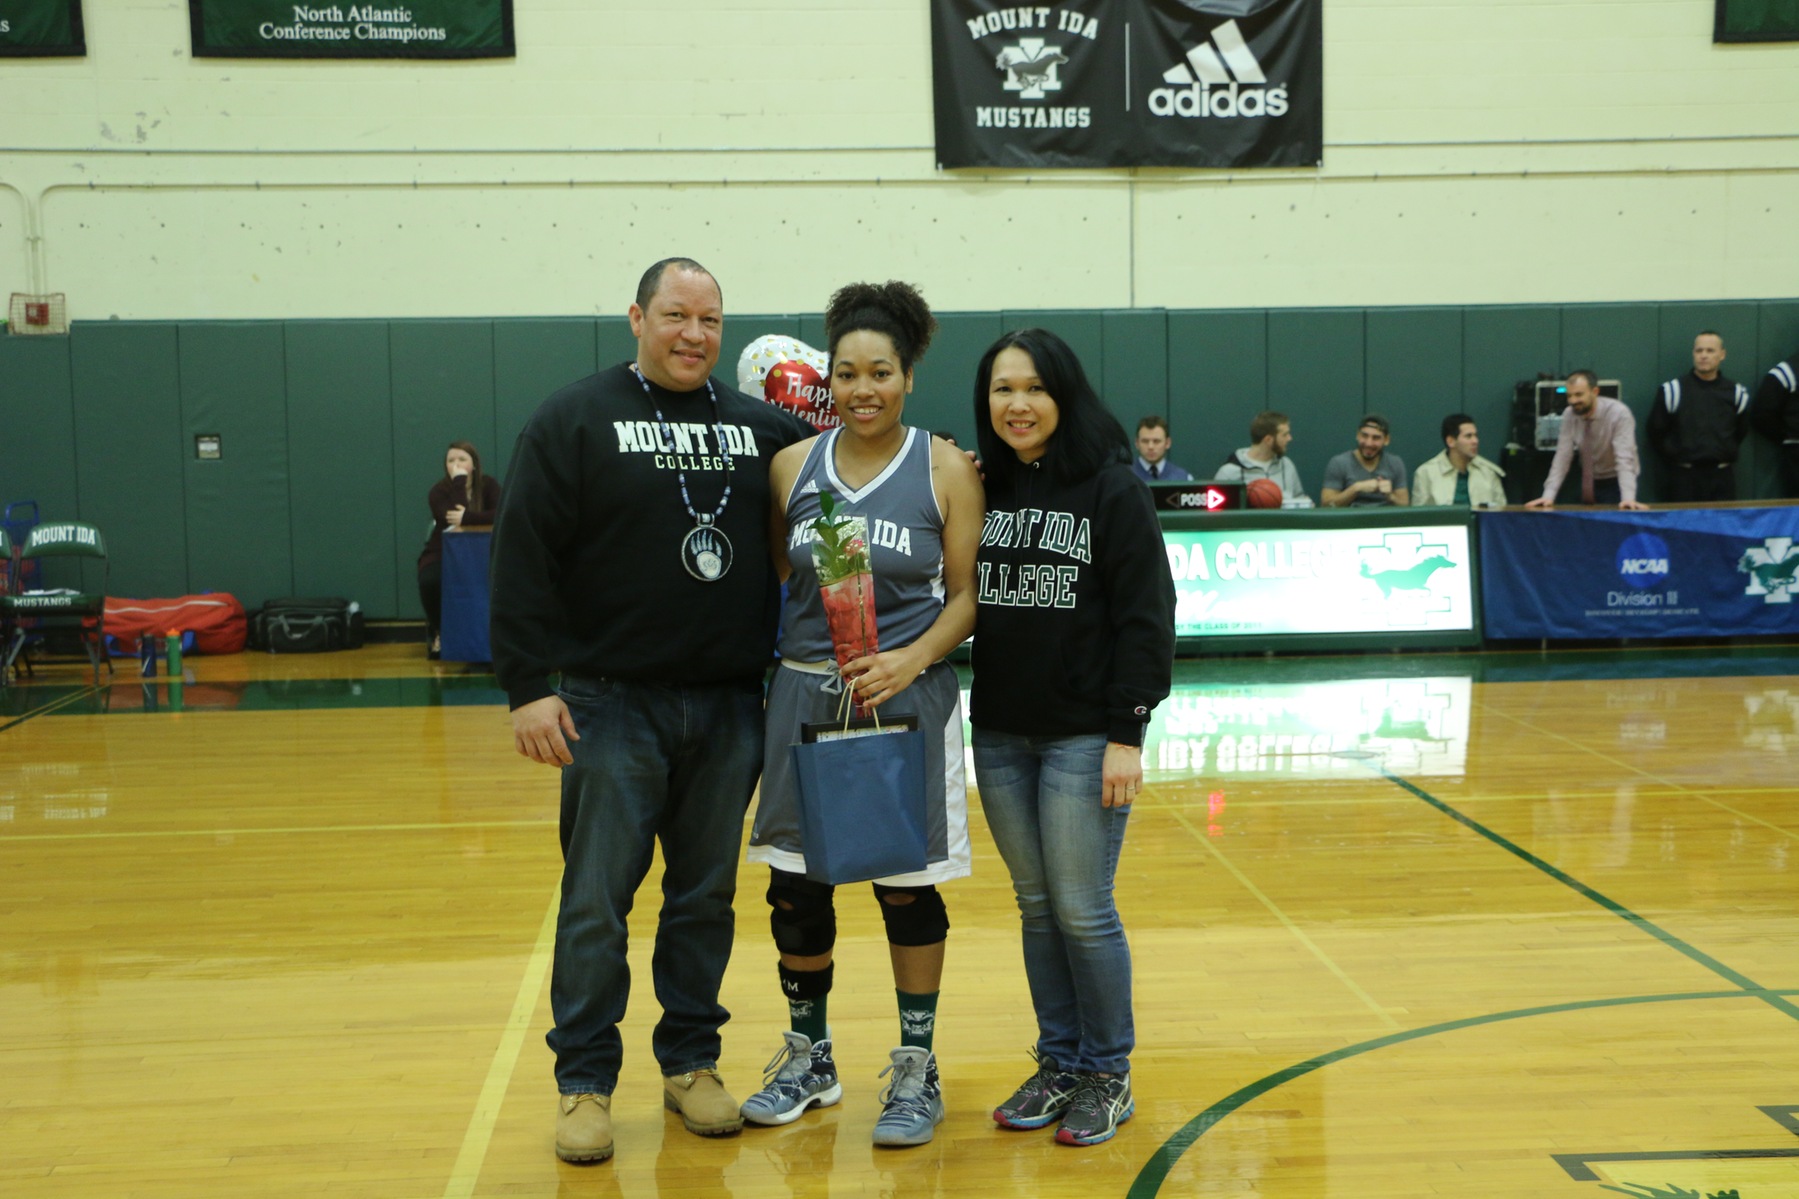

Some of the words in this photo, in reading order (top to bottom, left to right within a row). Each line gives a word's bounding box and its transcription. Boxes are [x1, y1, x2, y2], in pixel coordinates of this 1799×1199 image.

[292, 5, 343, 22] North
[347, 5, 412, 22] Atlantic
[966, 6, 1051, 40] MOUNT
[1058, 9, 1099, 40] IDA
[259, 22, 350, 40] Conference
[354, 22, 447, 44] Champions
[1147, 81, 1289, 118] adidas
[976, 106, 1091, 128] MUSTANGS
[786, 373, 835, 410] Happ
[613, 420, 709, 455] MOUNT
[713, 424, 760, 457] IDA
[654, 454, 736, 471] COLLEGE
[1181, 493, 1207, 506] POSS
[31, 524, 76, 547] MOUNT
[76, 526, 96, 545] IDA
[871, 518, 912, 557] IDA
[1038, 511, 1092, 564] IDA
[1166, 543, 1211, 581] DA
[1621, 558, 1669, 574] NCAA
[977, 561, 1078, 608] LLEGE
[13, 597, 72, 607] MUSTANGS
[1607, 590, 1663, 606] Division
